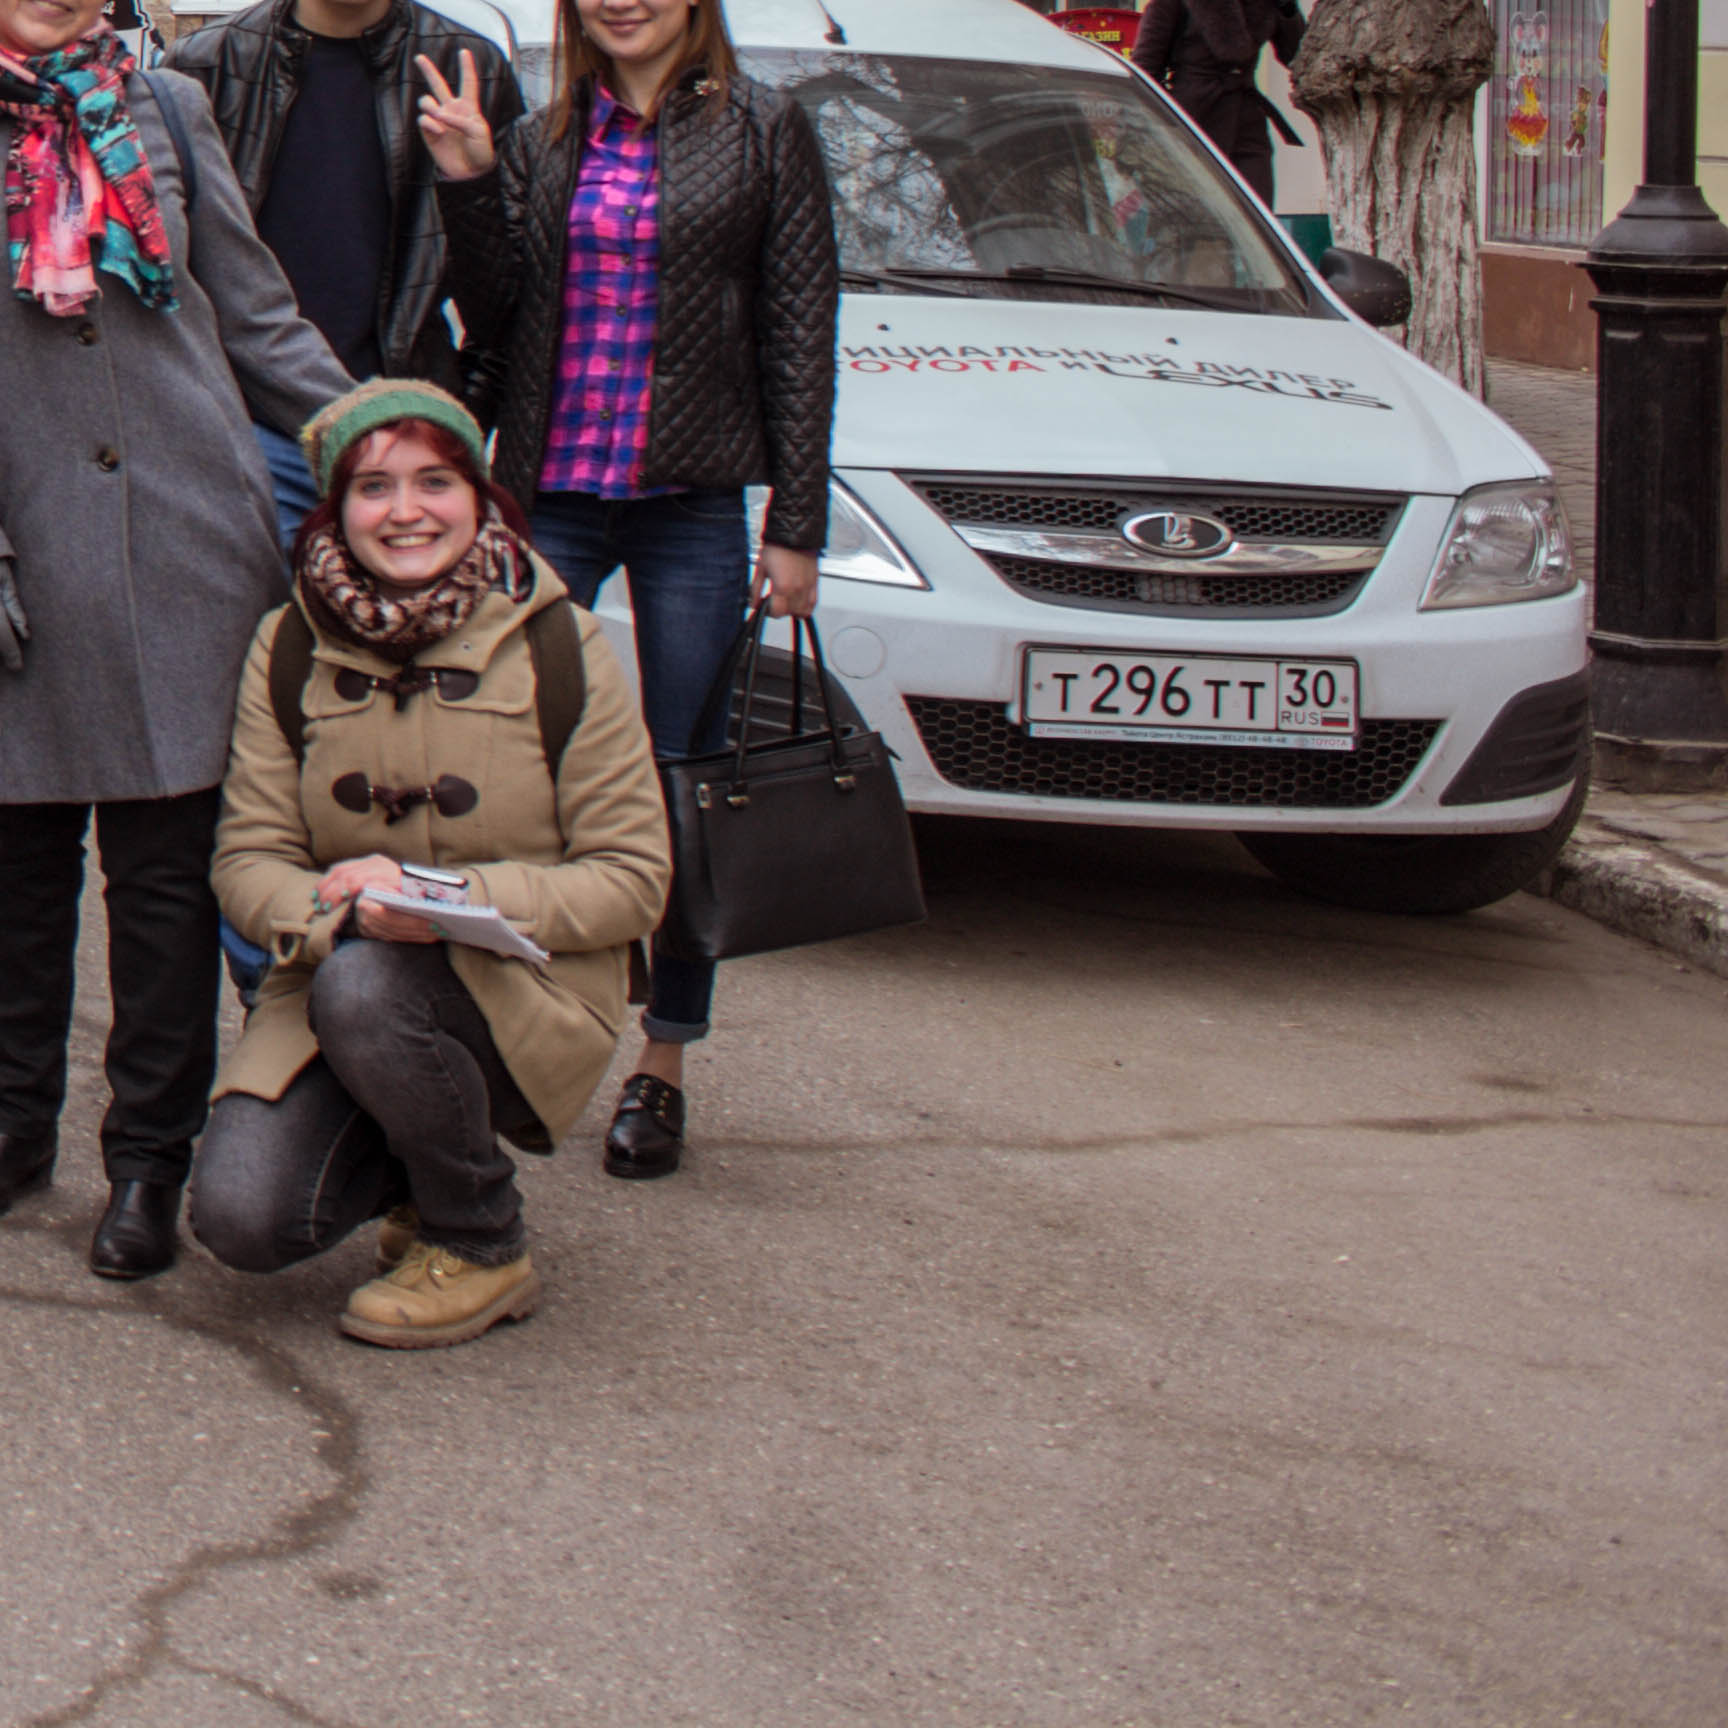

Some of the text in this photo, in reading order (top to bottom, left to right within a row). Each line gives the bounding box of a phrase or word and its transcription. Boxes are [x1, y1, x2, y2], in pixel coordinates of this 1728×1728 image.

[838, 357, 1048, 374] OYOTA
[1094, 363, 1394, 411] LEXUS
[842, 345, 1356, 390] ИЦИАЛЬНЫЙ ДИЛЕР
[1284, 667, 1336, 709] 30
[1280, 710, 1320, 726] RUS
